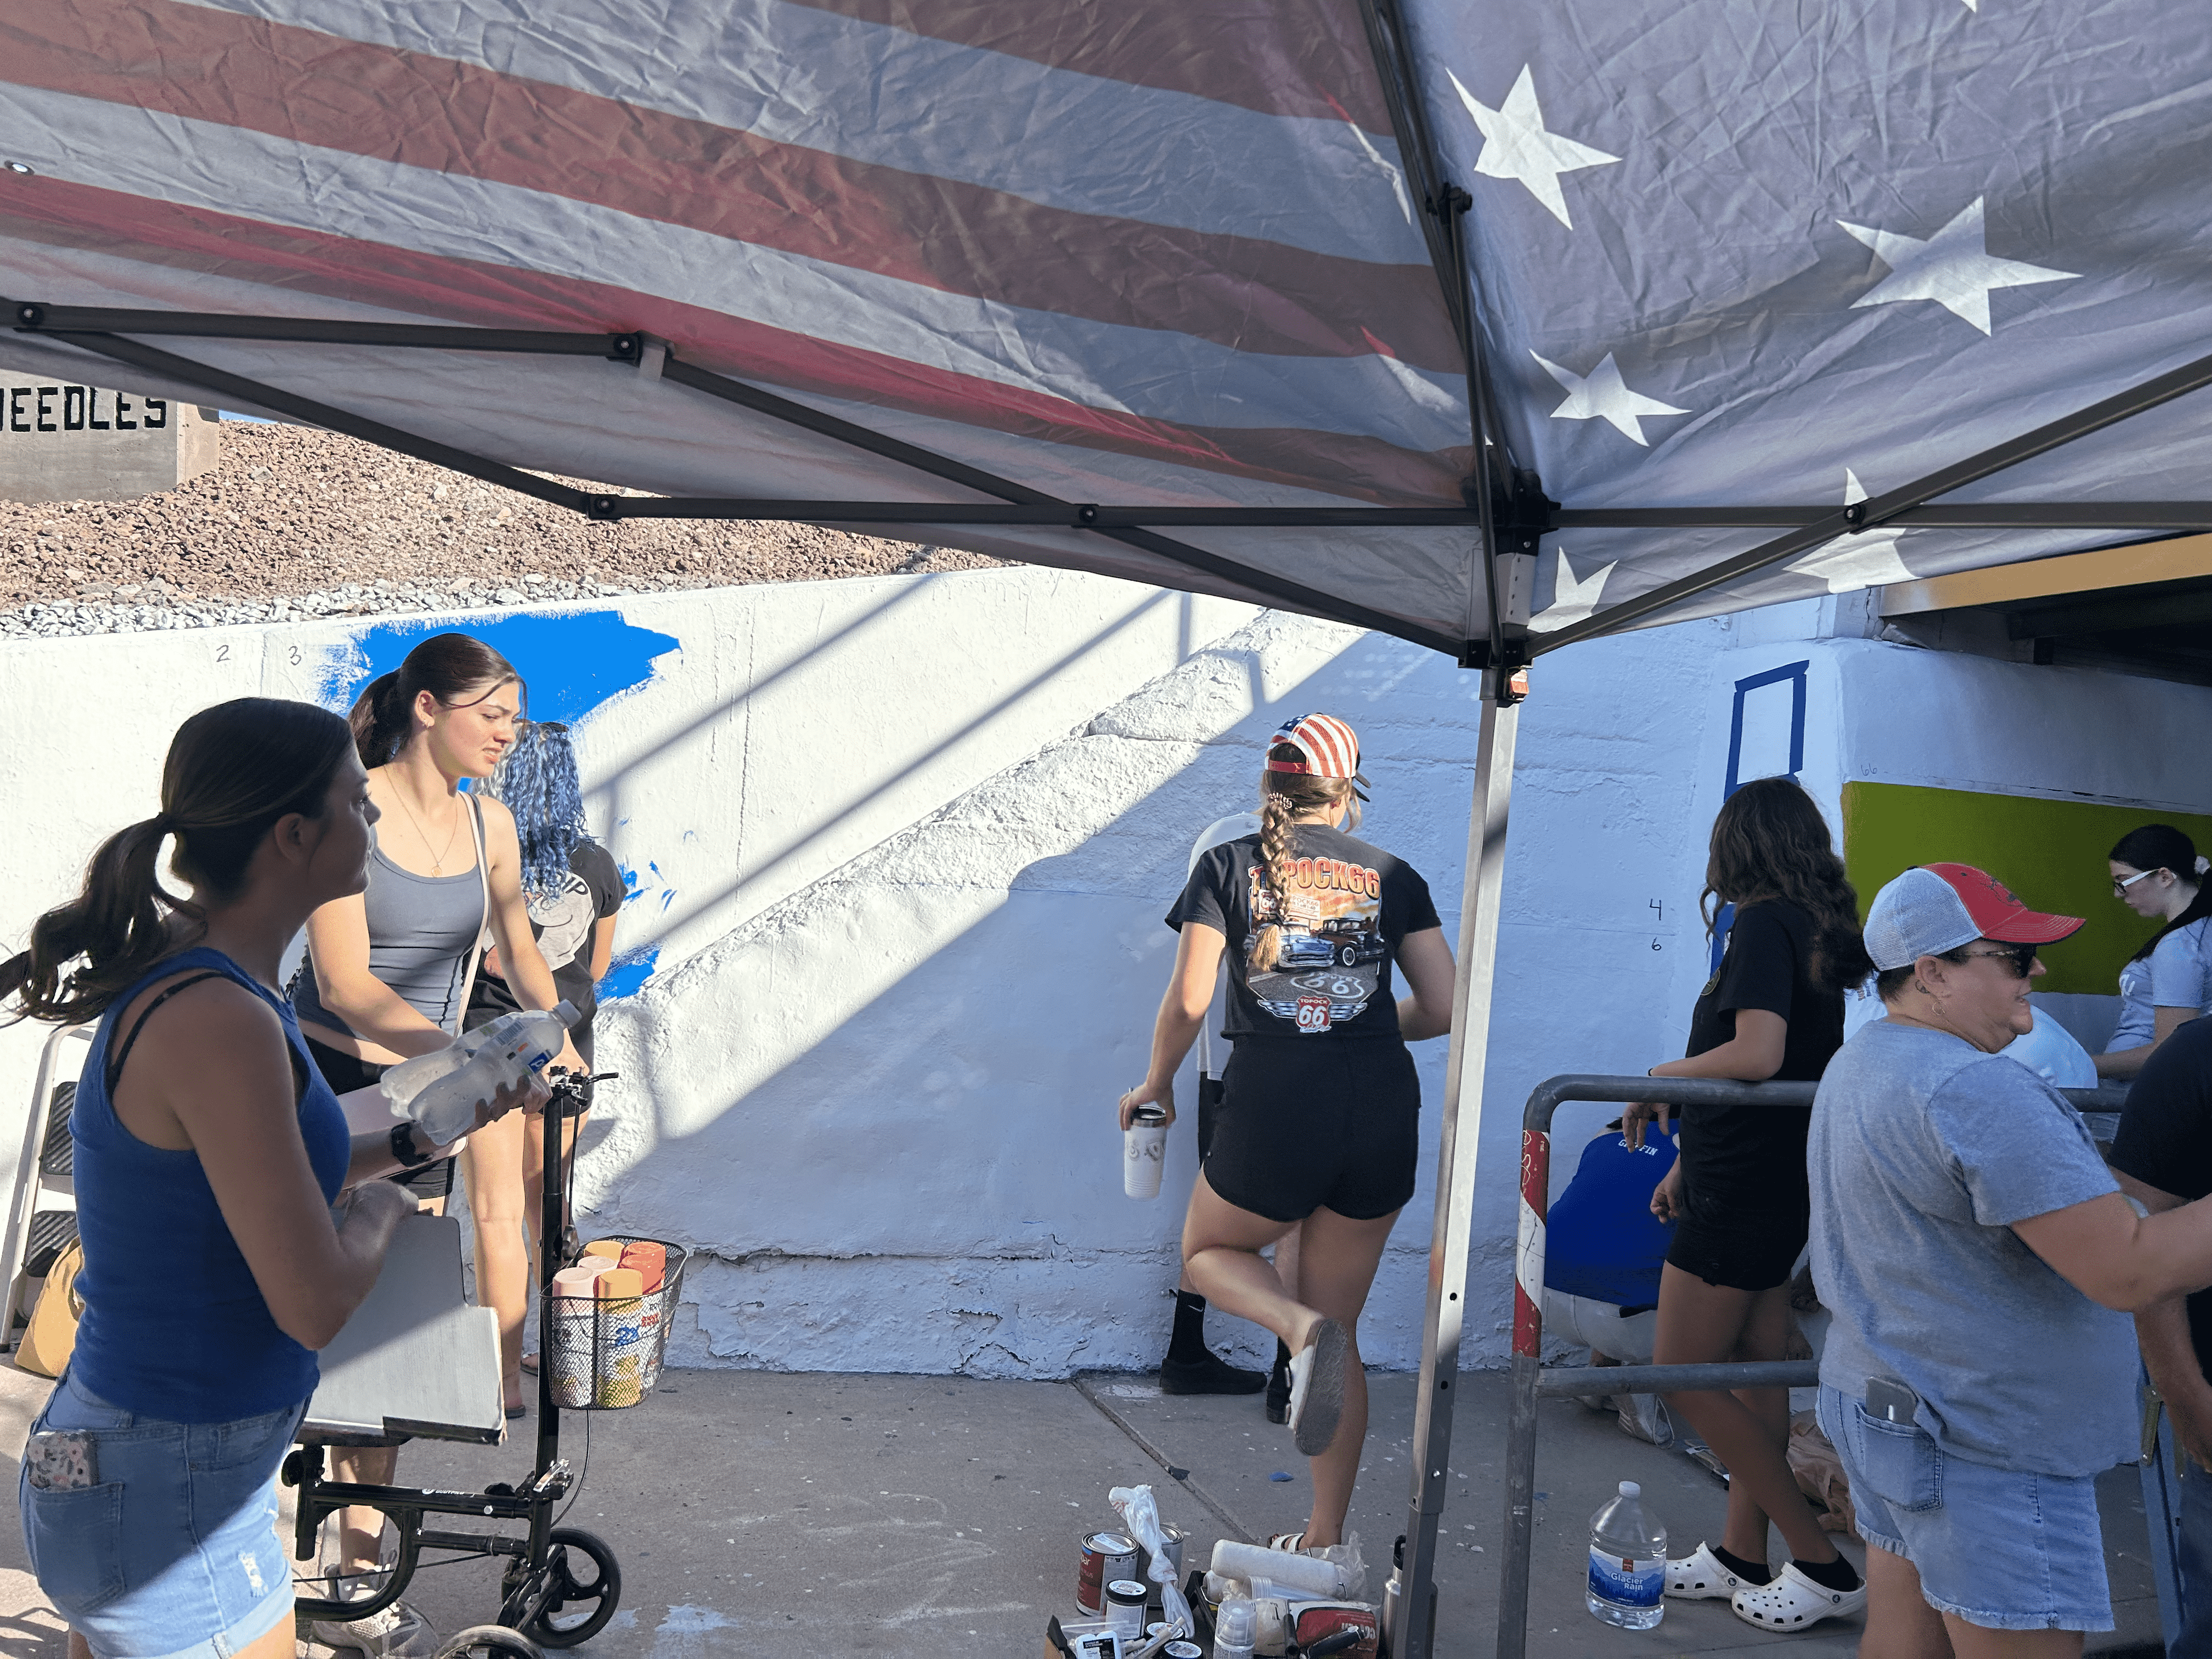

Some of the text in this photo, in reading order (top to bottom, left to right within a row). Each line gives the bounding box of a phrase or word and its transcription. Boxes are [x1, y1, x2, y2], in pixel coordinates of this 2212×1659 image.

[216, 645, 231, 663] 2
[289, 646, 302, 666] 3
[1860, 763, 1878, 776] 66
[1248, 856, 1381, 900] TPOCK66
[1650, 899, 1661, 921] 4
[1652, 937, 1662, 951] 6
[1298, 1005, 1327, 1025] 66
[1618, 1139, 1658, 1156] GFIN
[1610, 1572, 1644, 1585] Glacier
[1624, 1583, 1644, 1592] Rain
